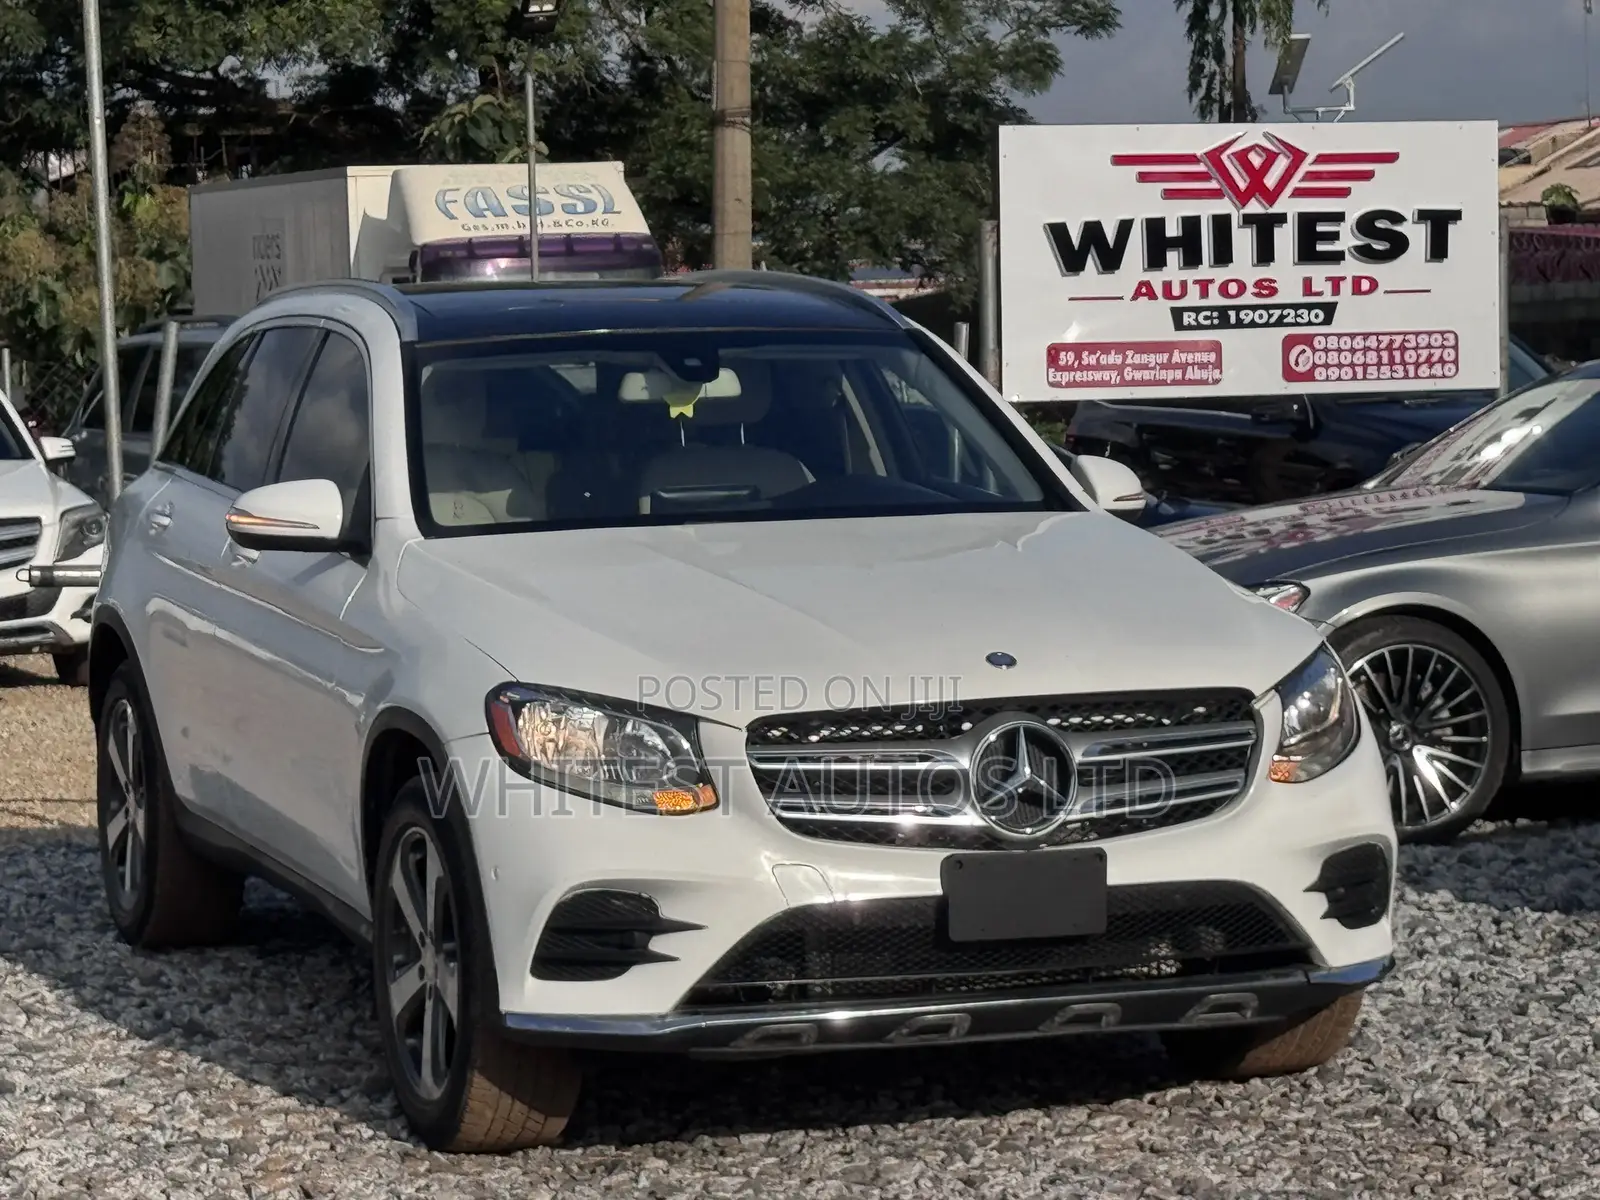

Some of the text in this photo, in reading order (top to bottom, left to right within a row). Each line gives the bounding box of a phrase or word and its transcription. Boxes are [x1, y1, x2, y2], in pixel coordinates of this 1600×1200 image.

[1043, 207, 1463, 277] WHITEST
[1130, 275, 1379, 301] AUTOS LTD
[1182, 308, 1325, 327] RC: 1907230
